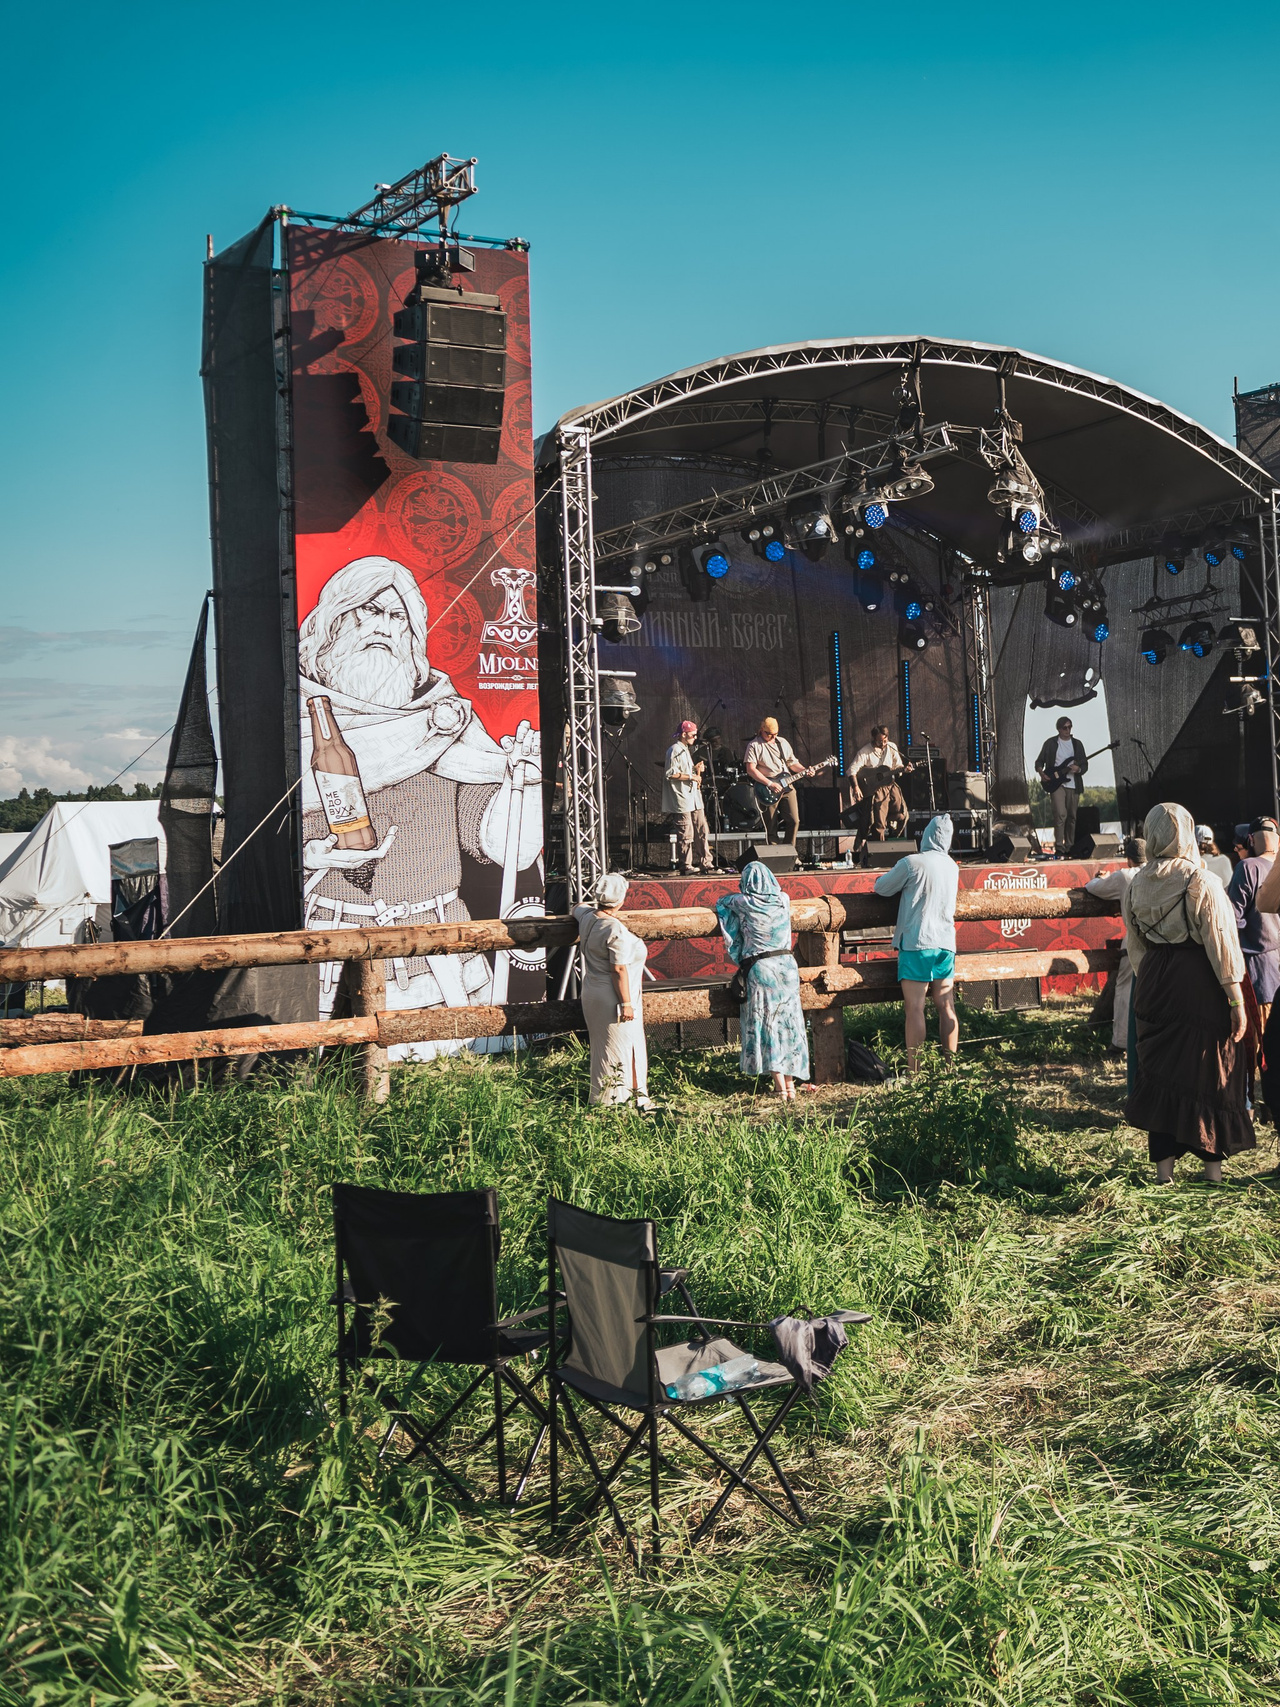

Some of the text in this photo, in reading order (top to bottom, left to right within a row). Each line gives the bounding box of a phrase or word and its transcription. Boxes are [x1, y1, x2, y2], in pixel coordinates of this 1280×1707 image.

[731, 613, 788, 651] БЕРЕГ
[478, 682, 525, 690] ВОЗРОЖДЕНИЕ
[325, 790, 340, 800] МЕ
[328, 798, 342, 808] ДО
[328, 805, 356, 817] ВУХА
[522, 896, 541, 905] БЕЗ
